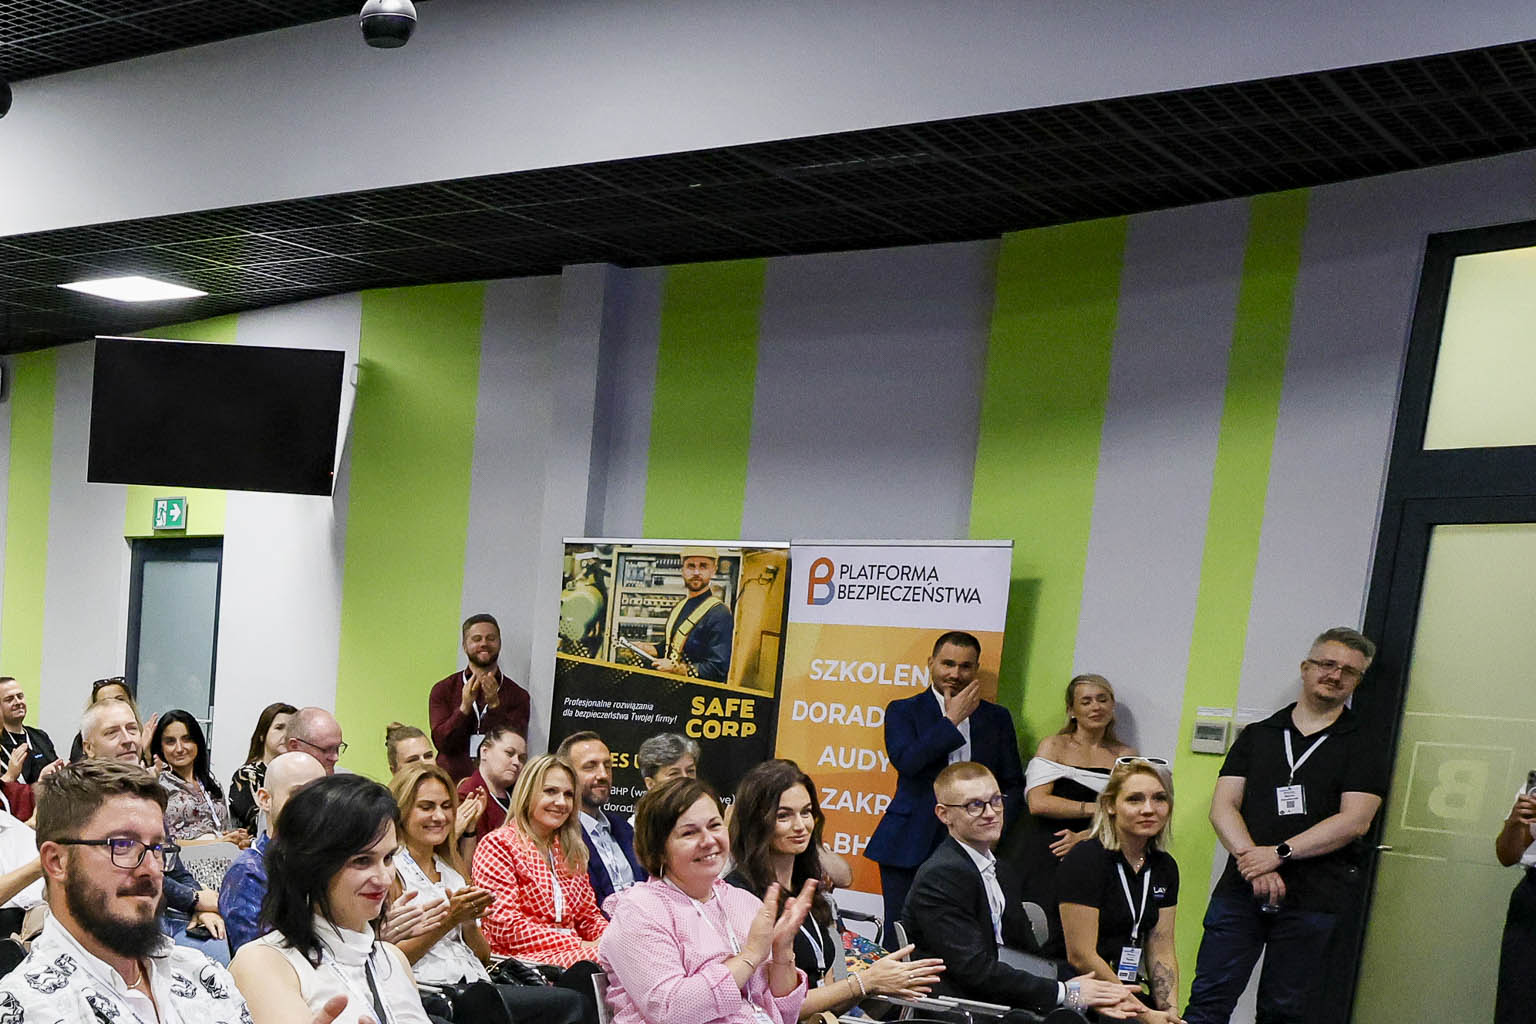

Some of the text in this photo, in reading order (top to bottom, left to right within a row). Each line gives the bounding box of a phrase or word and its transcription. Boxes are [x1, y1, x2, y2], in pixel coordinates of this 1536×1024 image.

[839, 564, 939, 582] PLATFORMA
[837, 582, 982, 604] BEZPIECZEŃSTWA
[809, 658, 931, 687] SZKOLEN
[563, 697, 654, 711] Profesjonalne rozwiązania
[691, 695, 756, 719] SAFE
[792, 700, 887, 728] DORAD
[562, 709, 678, 725] dla bezpieczeństwa Twojej firmy!
[685, 719, 757, 739] CORP
[610, 752, 630, 768] ES
[817, 745, 890, 773] AUDY
[603, 802, 635, 813] dorad
[819, 787, 893, 815] ZAKR
[833, 832, 872, 856] BH
